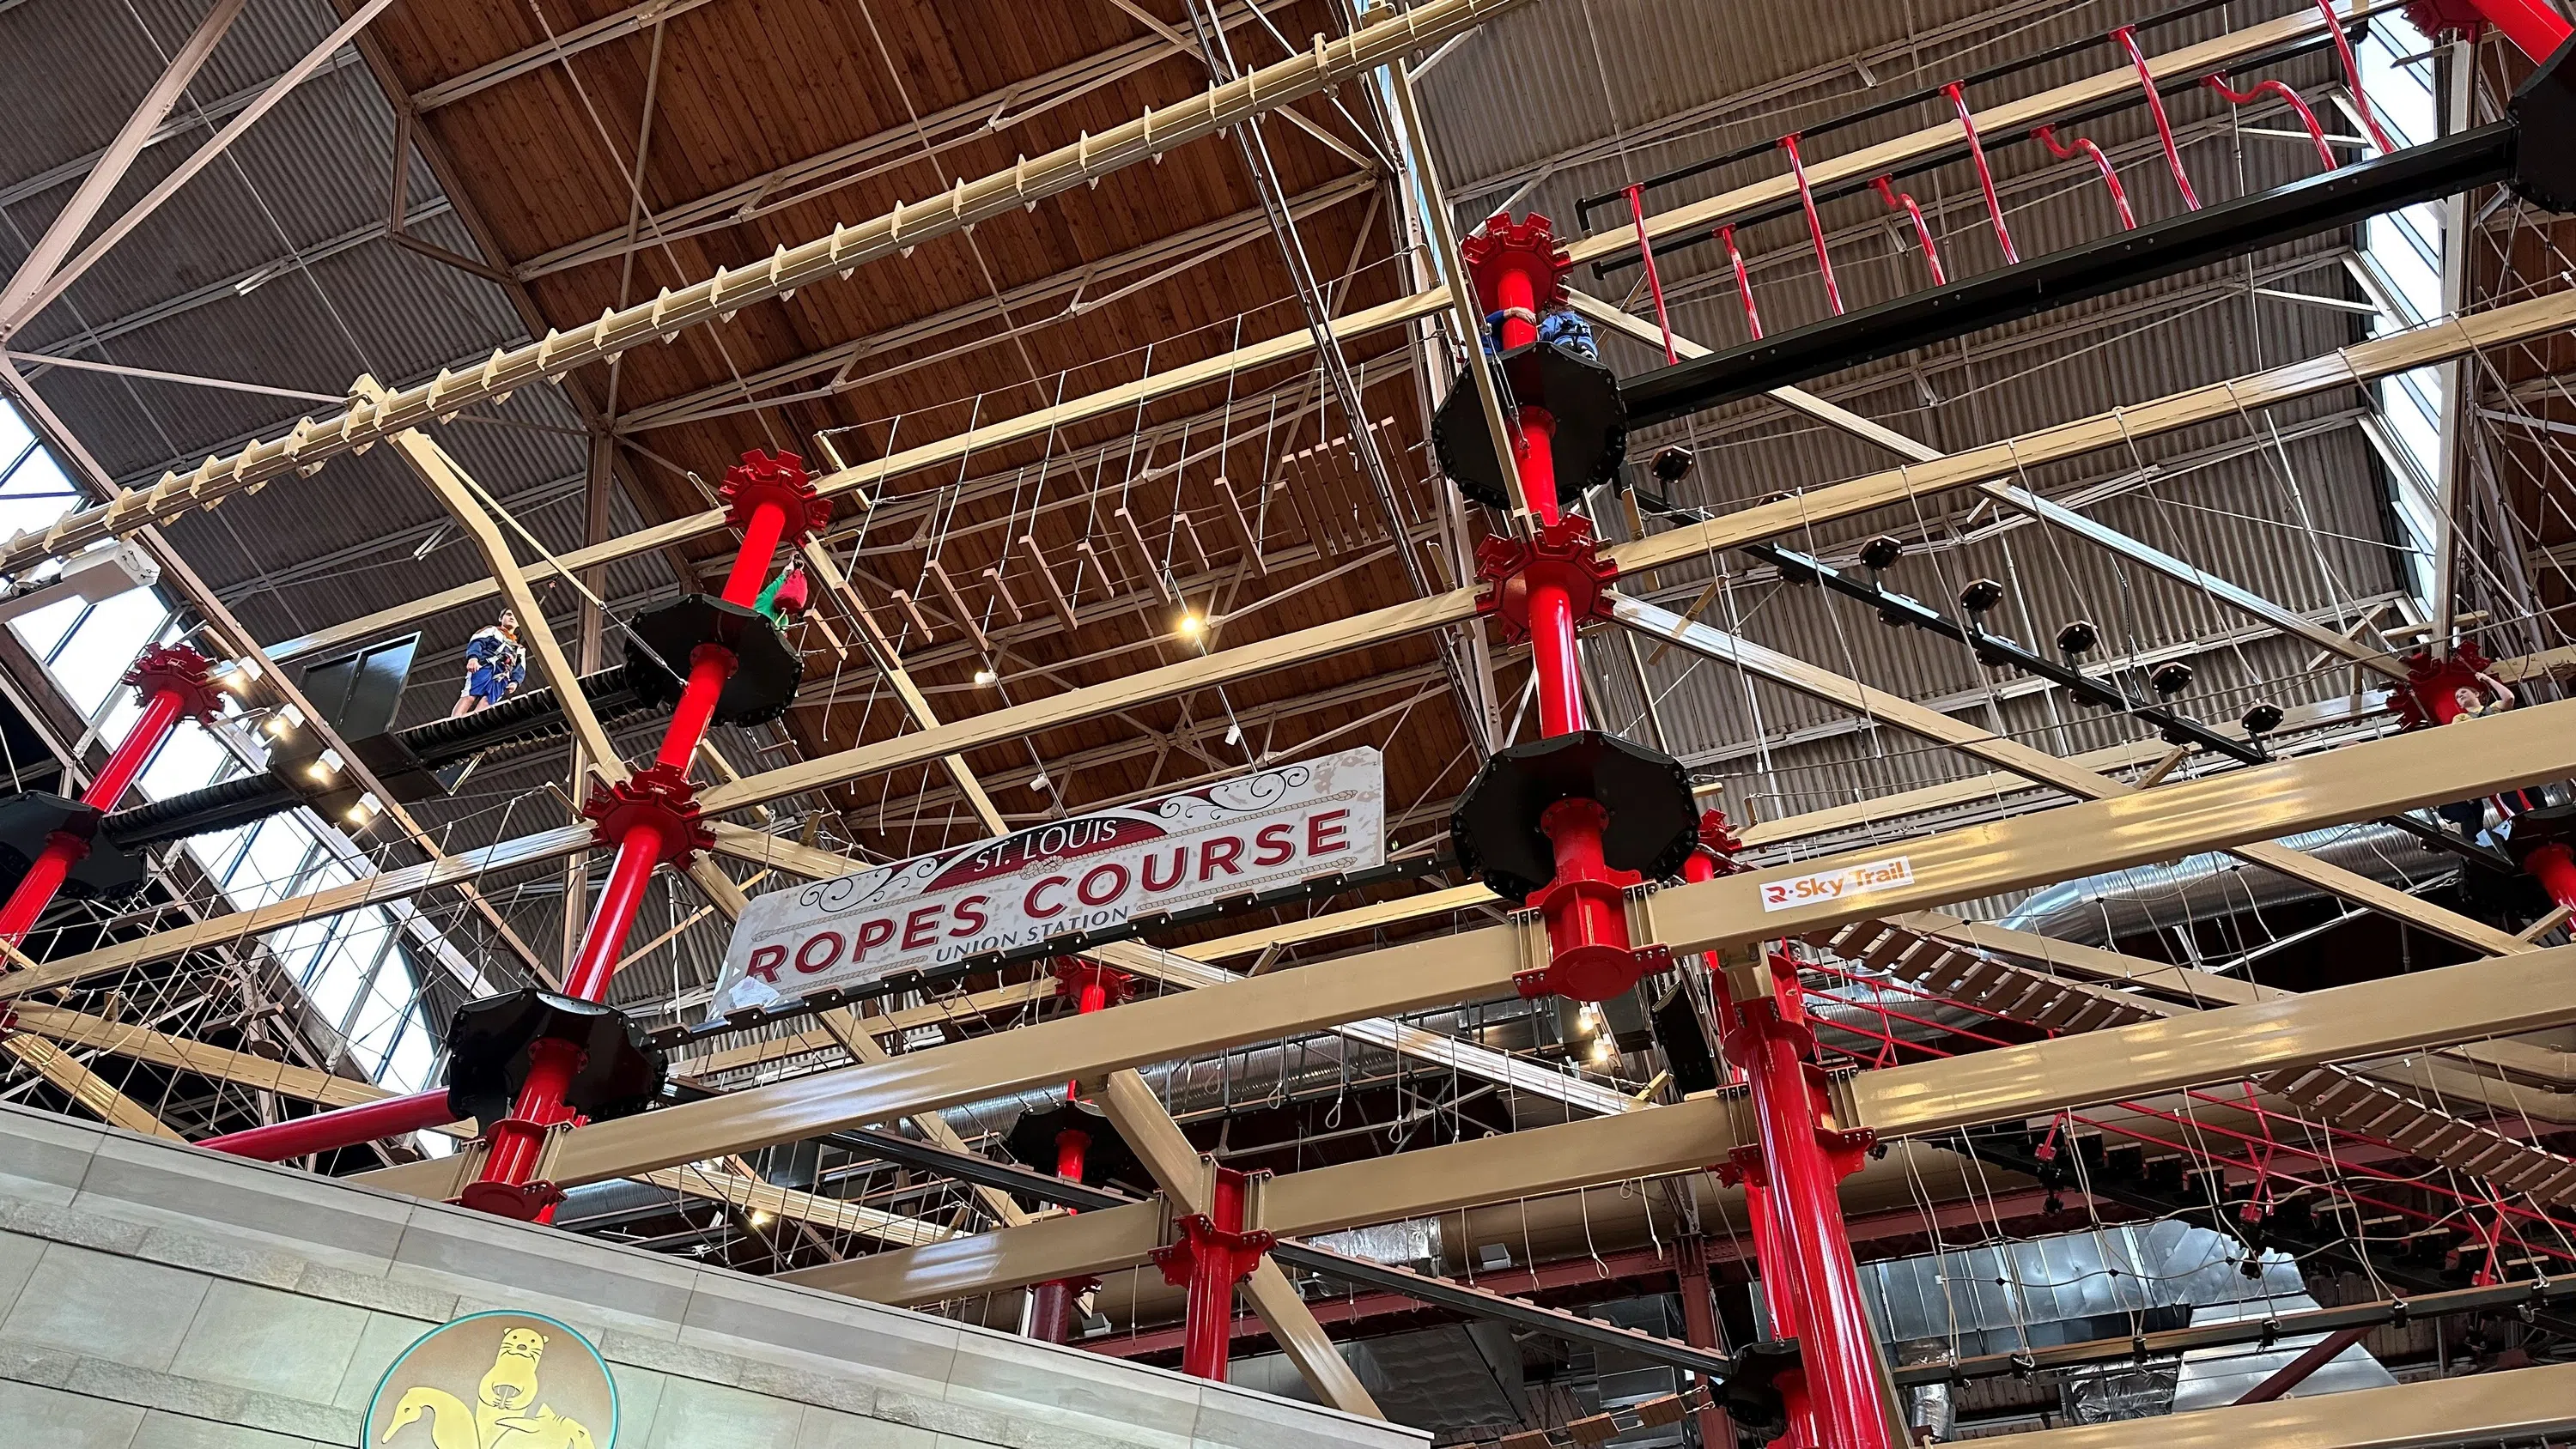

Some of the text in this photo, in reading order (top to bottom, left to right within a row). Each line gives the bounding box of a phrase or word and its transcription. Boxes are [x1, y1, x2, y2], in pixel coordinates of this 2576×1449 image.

[974, 820, 1117, 873] ST. LOUIS
[745, 808, 1351, 985] ROPES COURSE
[1795, 877, 1844, 897] Sky
[1849, 861, 1905, 887] Trail
[936, 906, 1128, 962] UNION STATION
